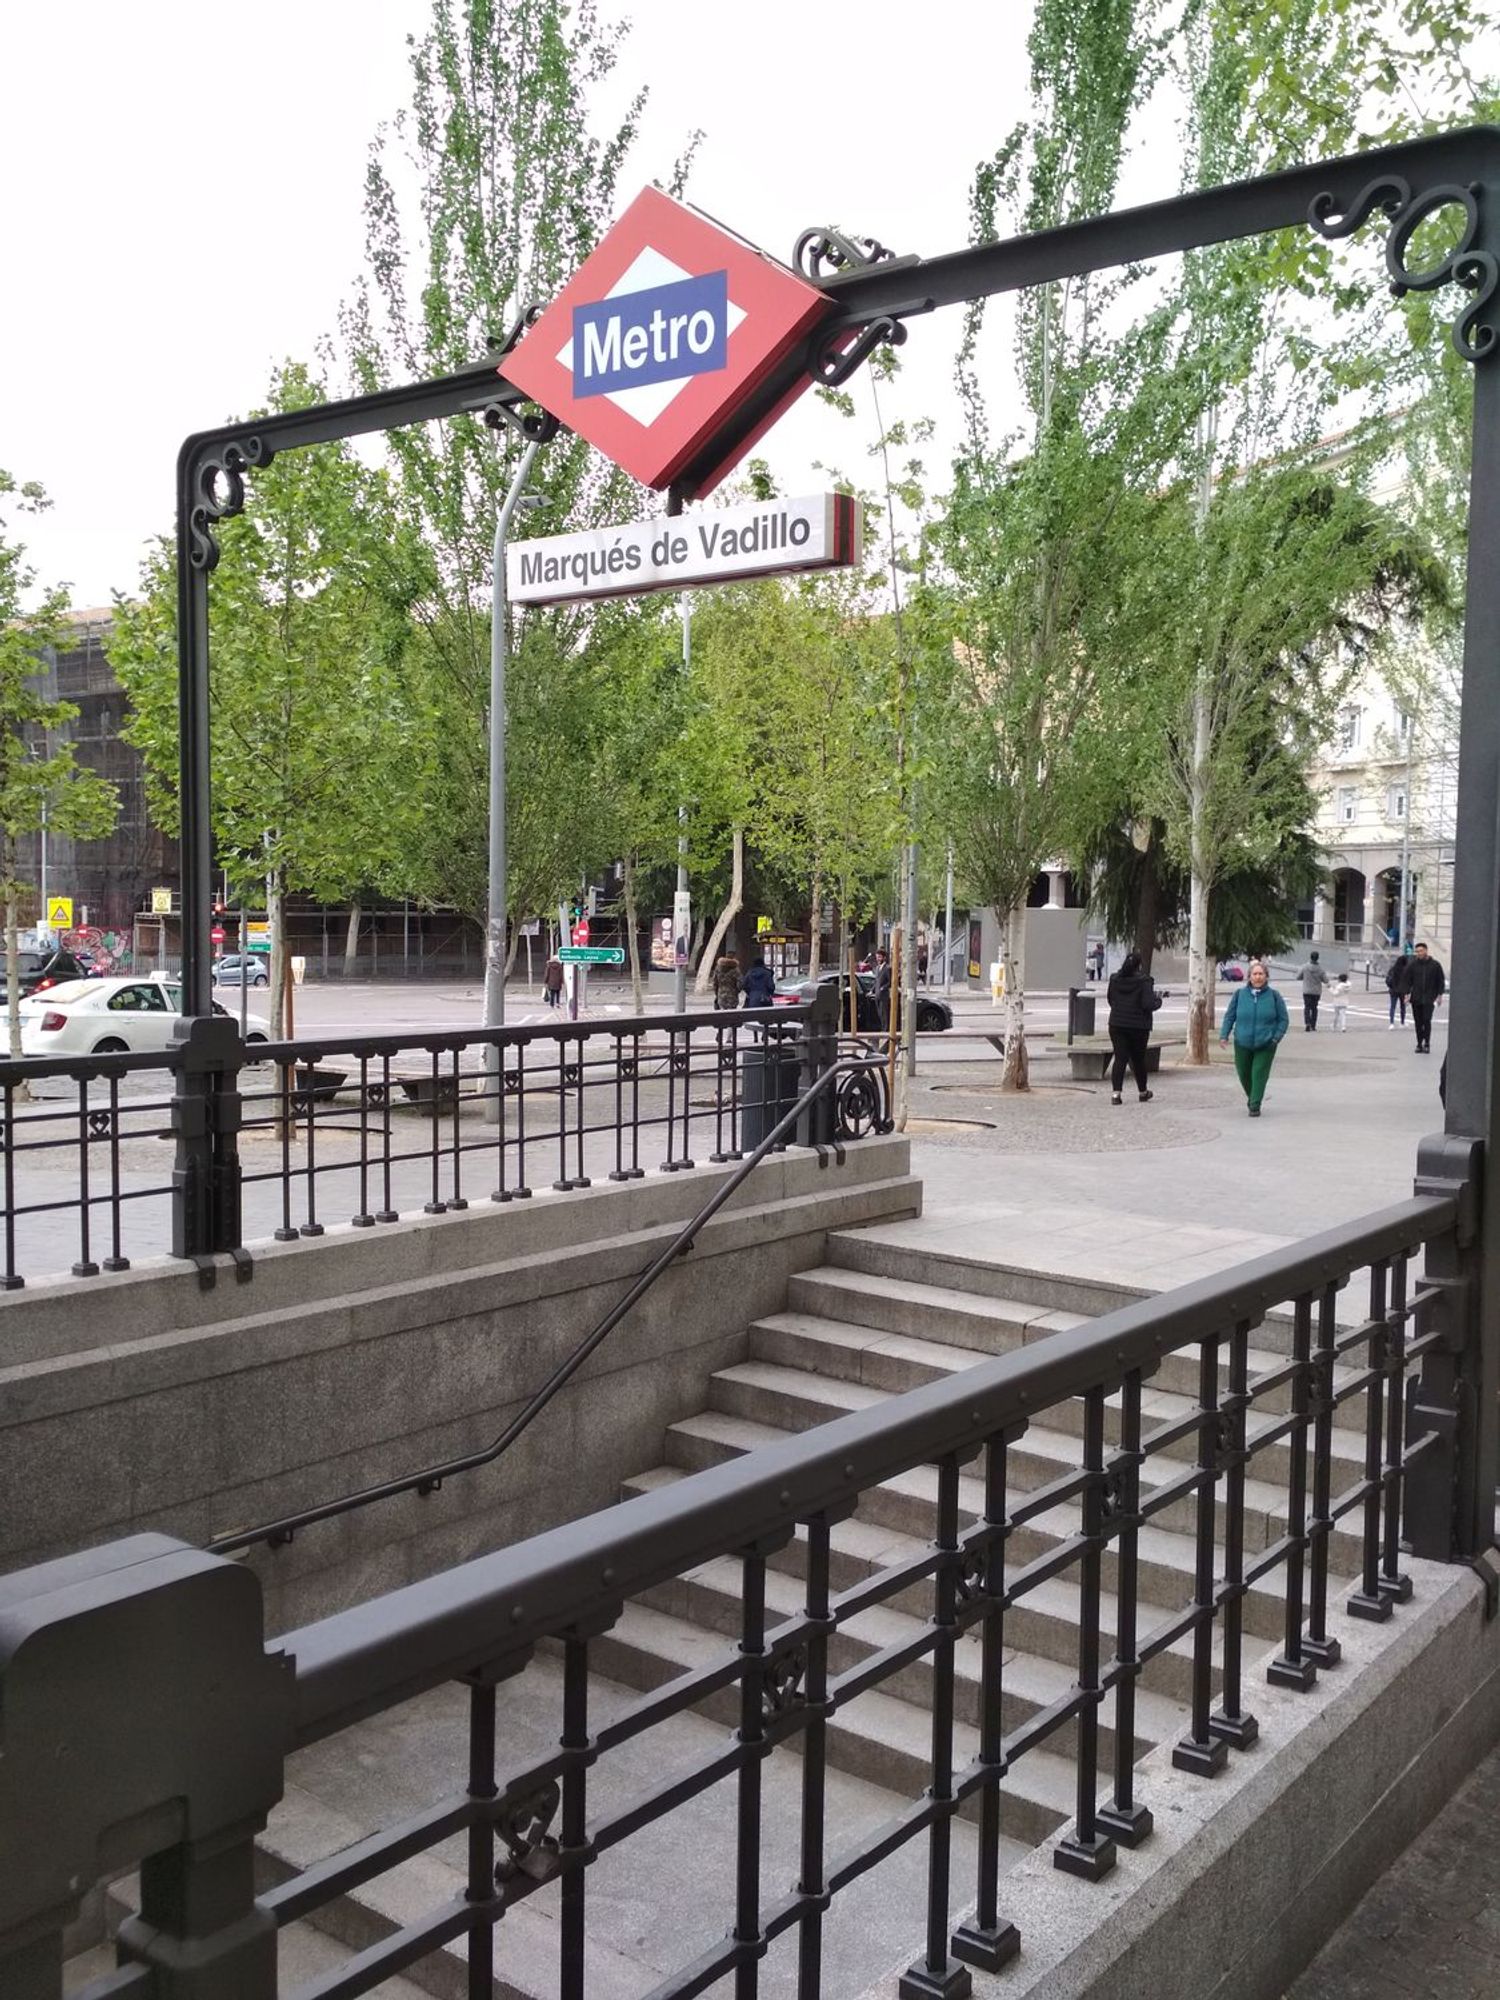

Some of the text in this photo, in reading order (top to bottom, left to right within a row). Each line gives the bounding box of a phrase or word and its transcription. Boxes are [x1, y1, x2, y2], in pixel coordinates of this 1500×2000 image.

[583, 309, 715, 379] Metro
[520, 511, 811, 587] Marqués de Vadillo
